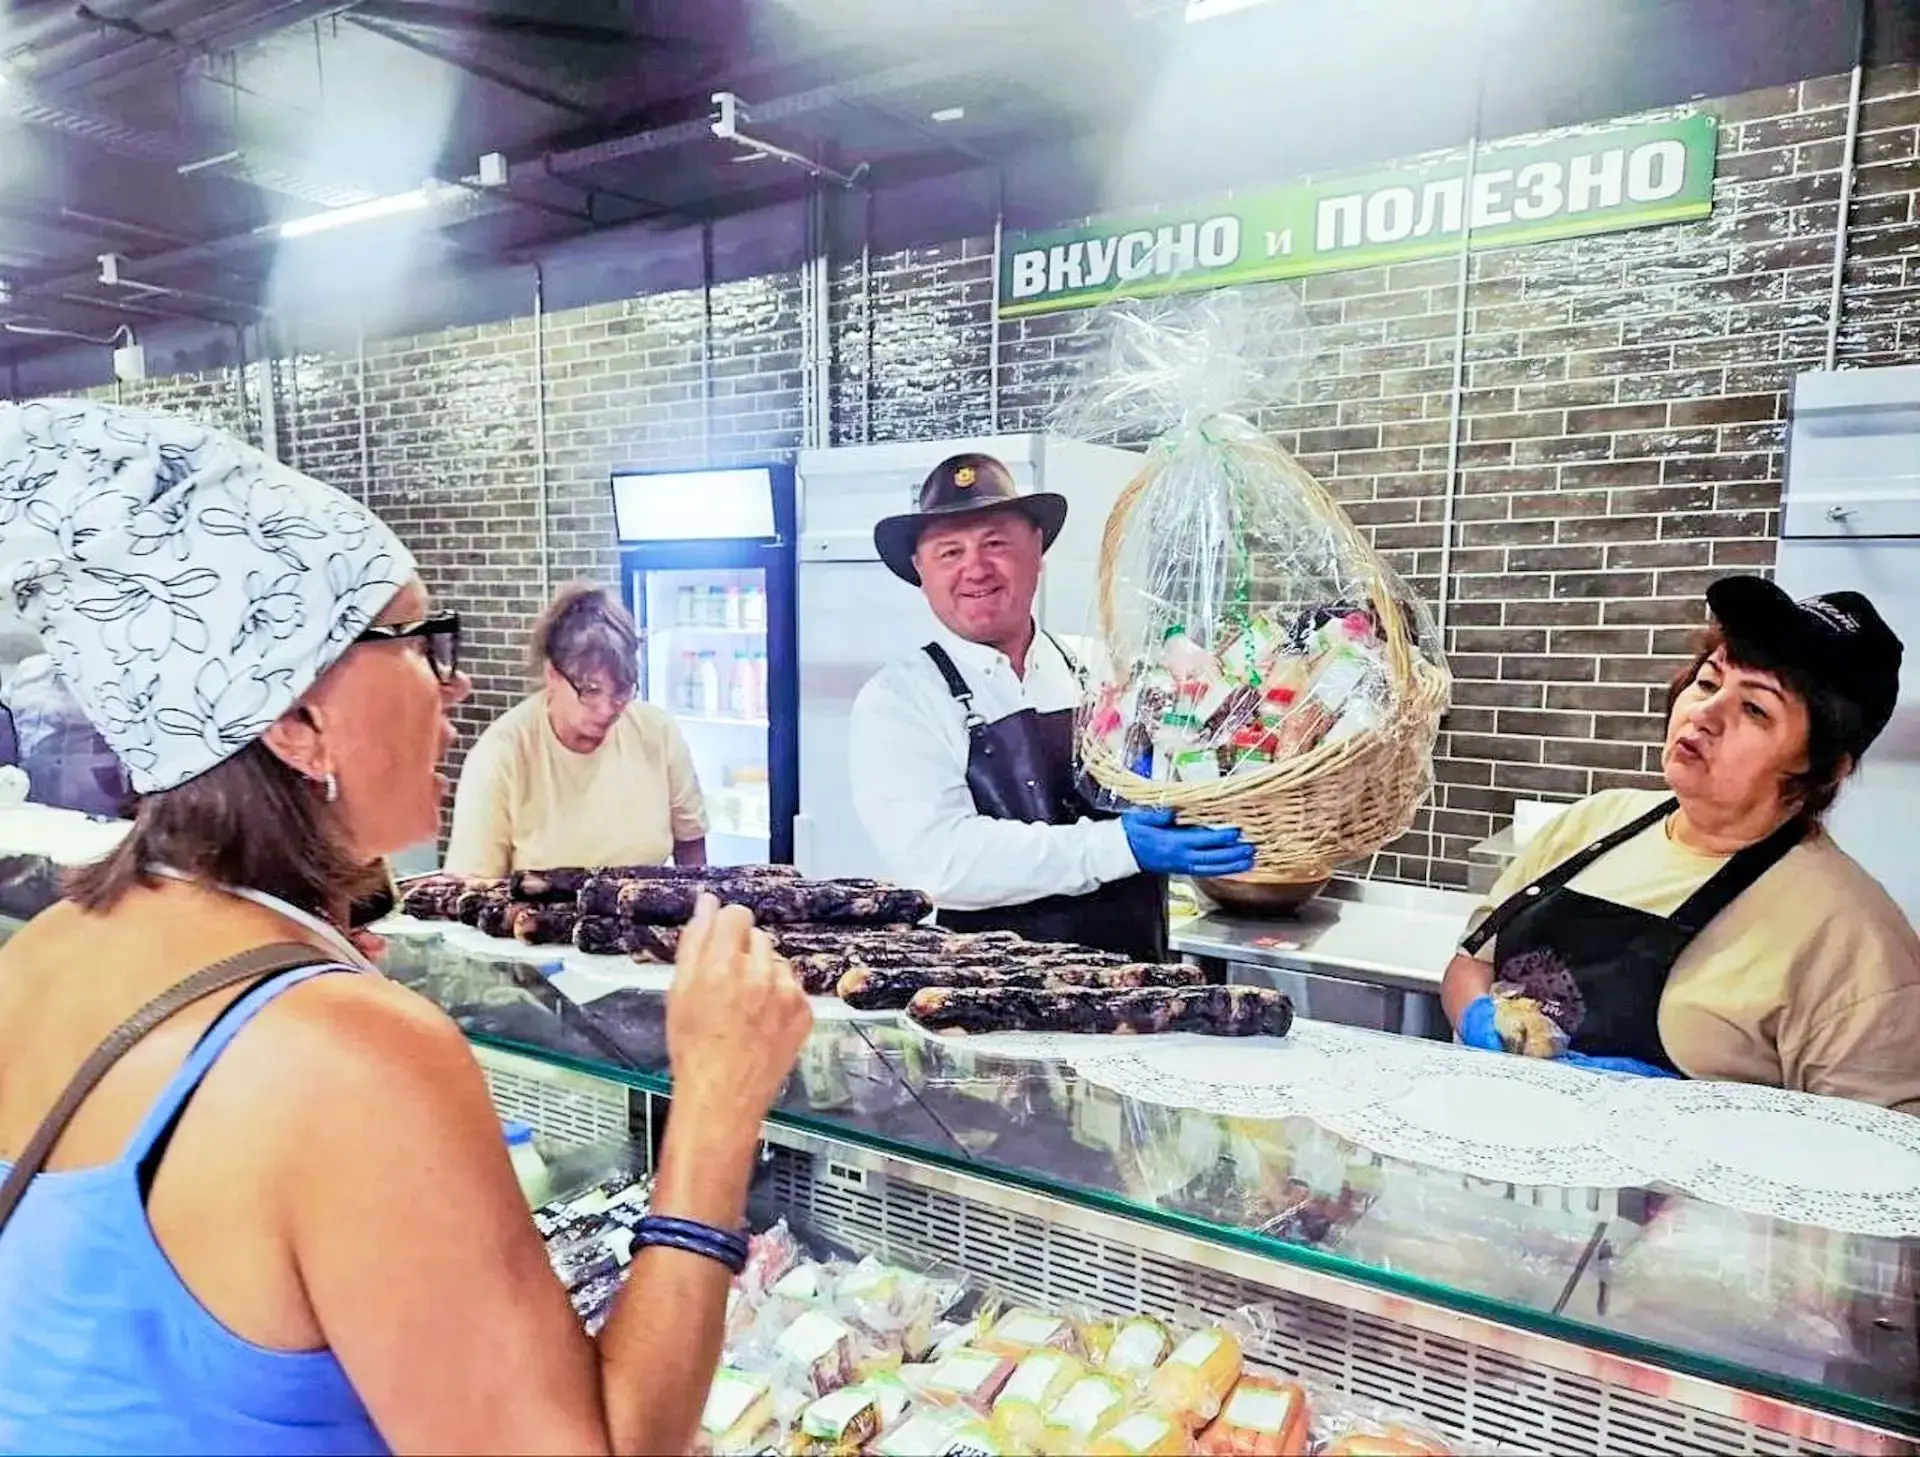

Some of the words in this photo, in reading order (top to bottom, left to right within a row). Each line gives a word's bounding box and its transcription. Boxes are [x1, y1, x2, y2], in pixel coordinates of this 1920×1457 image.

[1012, 216, 1240, 298] ВКУСНО
[1264, 227, 1293, 256] и
[1316, 139, 1686, 251] ПОЛЕЗНО
